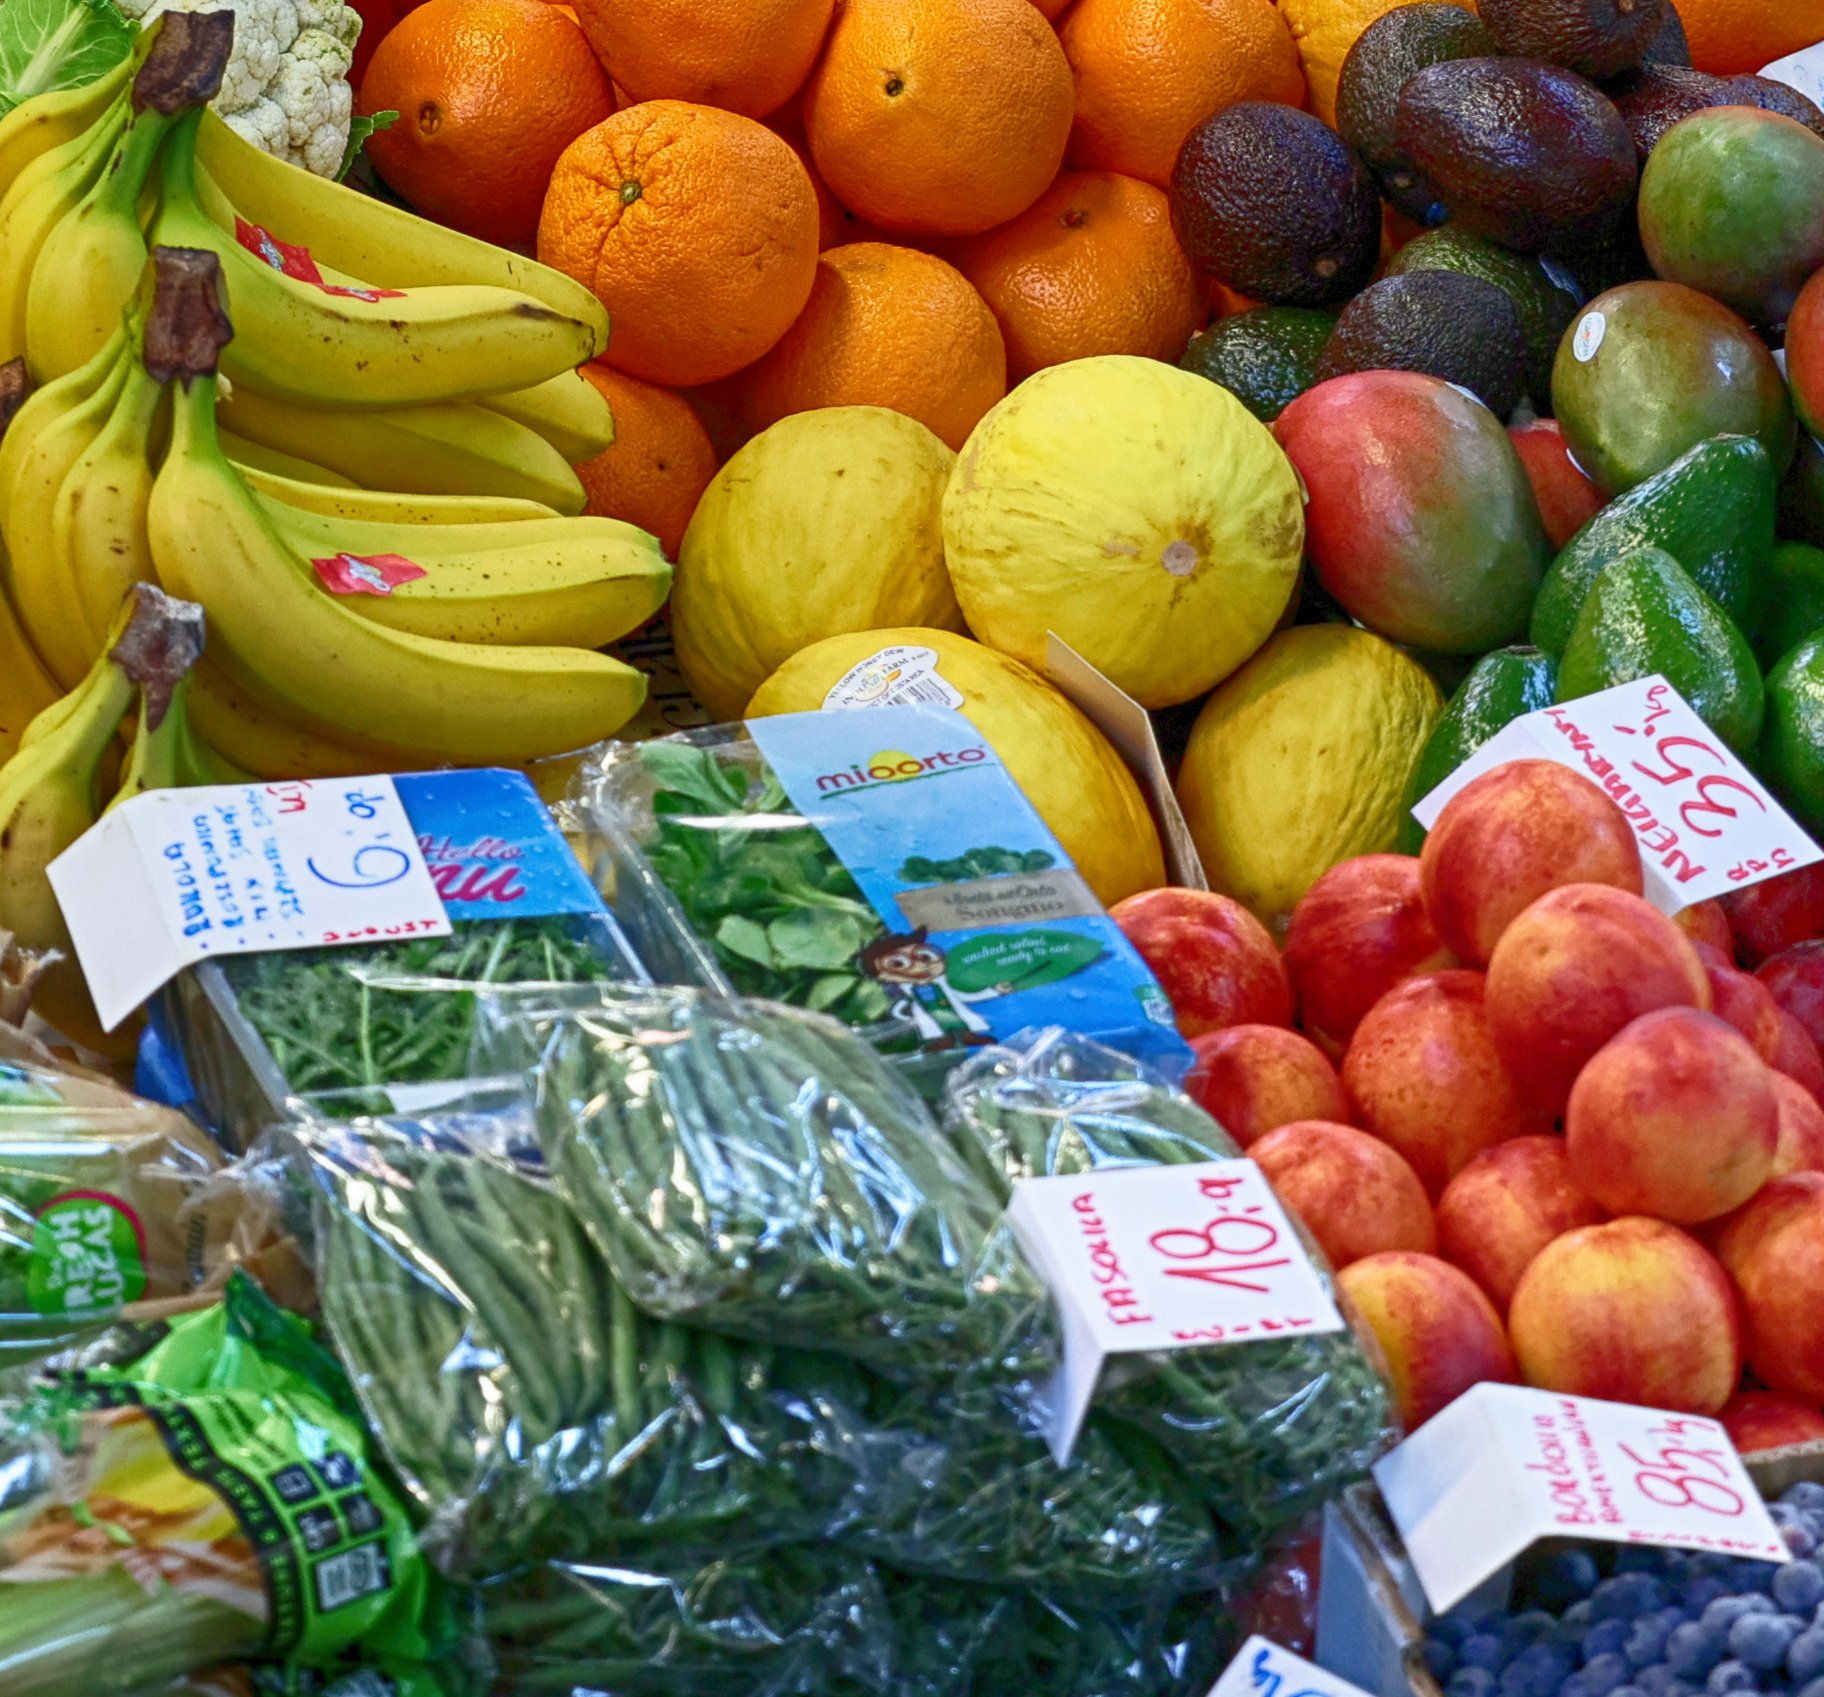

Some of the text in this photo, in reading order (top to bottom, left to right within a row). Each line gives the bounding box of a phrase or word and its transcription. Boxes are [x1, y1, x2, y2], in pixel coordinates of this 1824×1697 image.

[815, 747, 986, 791] mioorto
[417, 834, 524, 861] Hello
[1727, 847, 1795, 881] RPA
[160, 840, 226, 938] RUKOLA
[1071, 1192, 1153, 1326] FASOLKA
